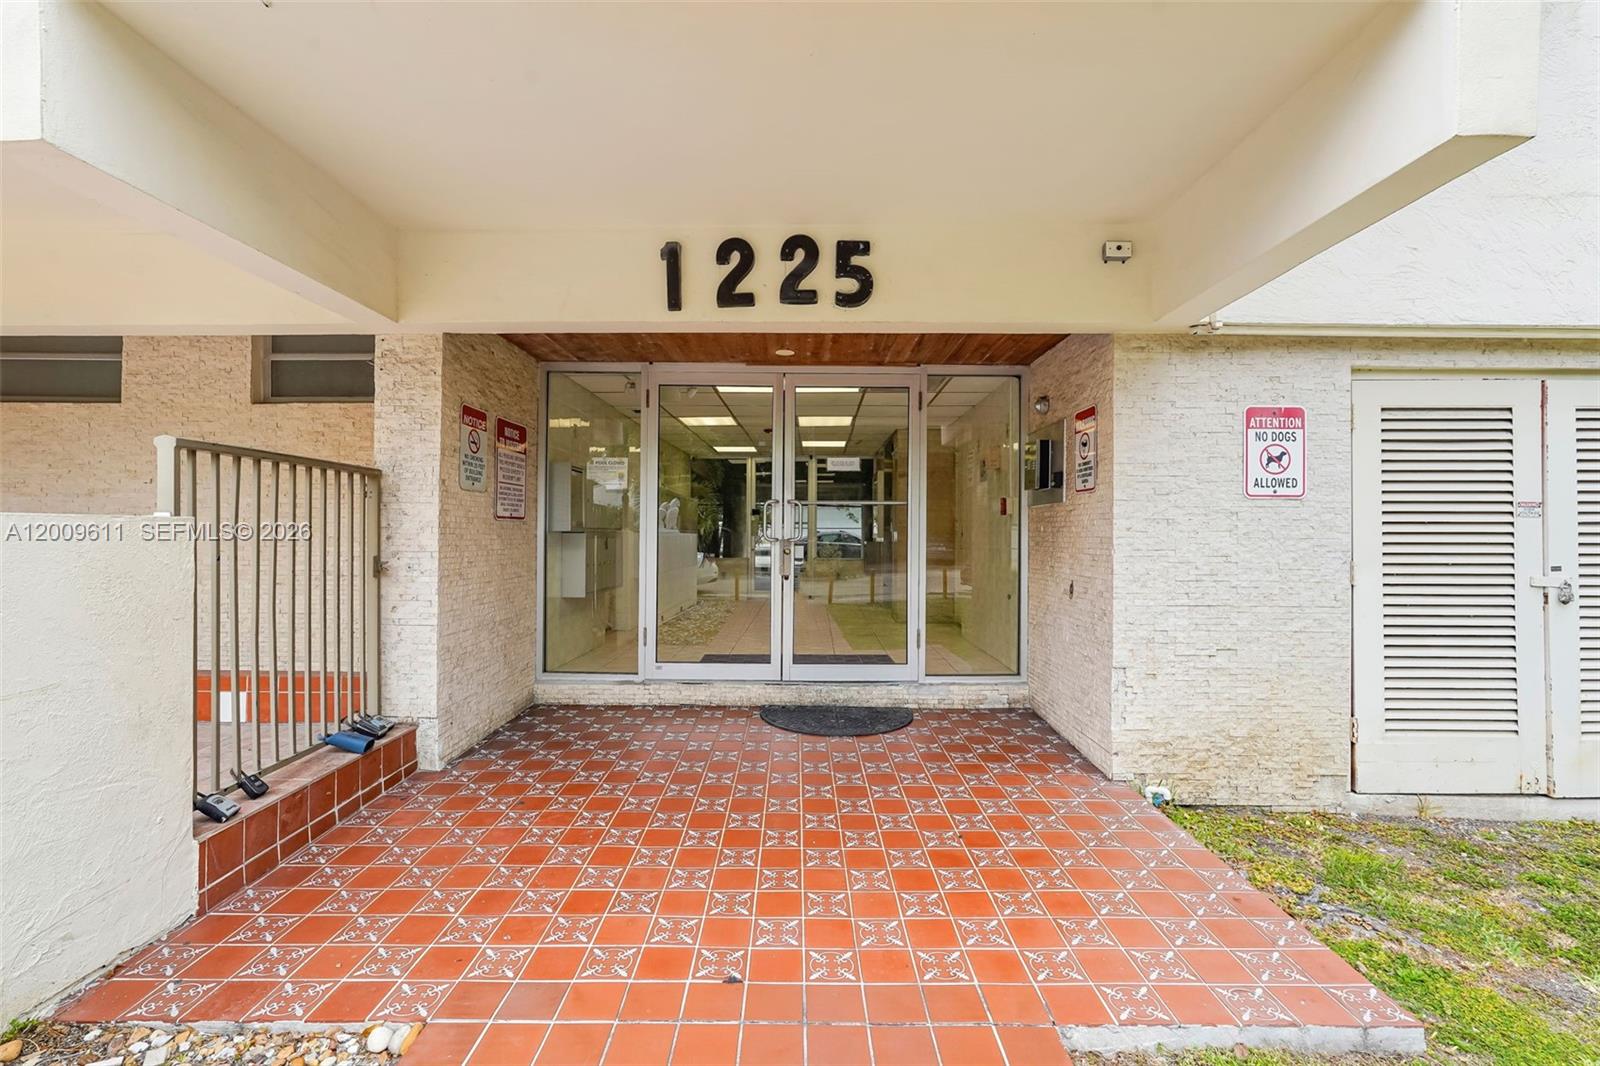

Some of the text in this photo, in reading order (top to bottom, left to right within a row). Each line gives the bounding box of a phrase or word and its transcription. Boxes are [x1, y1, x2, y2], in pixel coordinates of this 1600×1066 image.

[660, 234, 874, 311] 1225
[463, 414, 487, 431] NOTICE
[1249, 417, 1302, 428] ATTENTION
[1255, 431, 1297, 442] NO DOGS
[1253, 477, 1298, 488] ALLOWED
